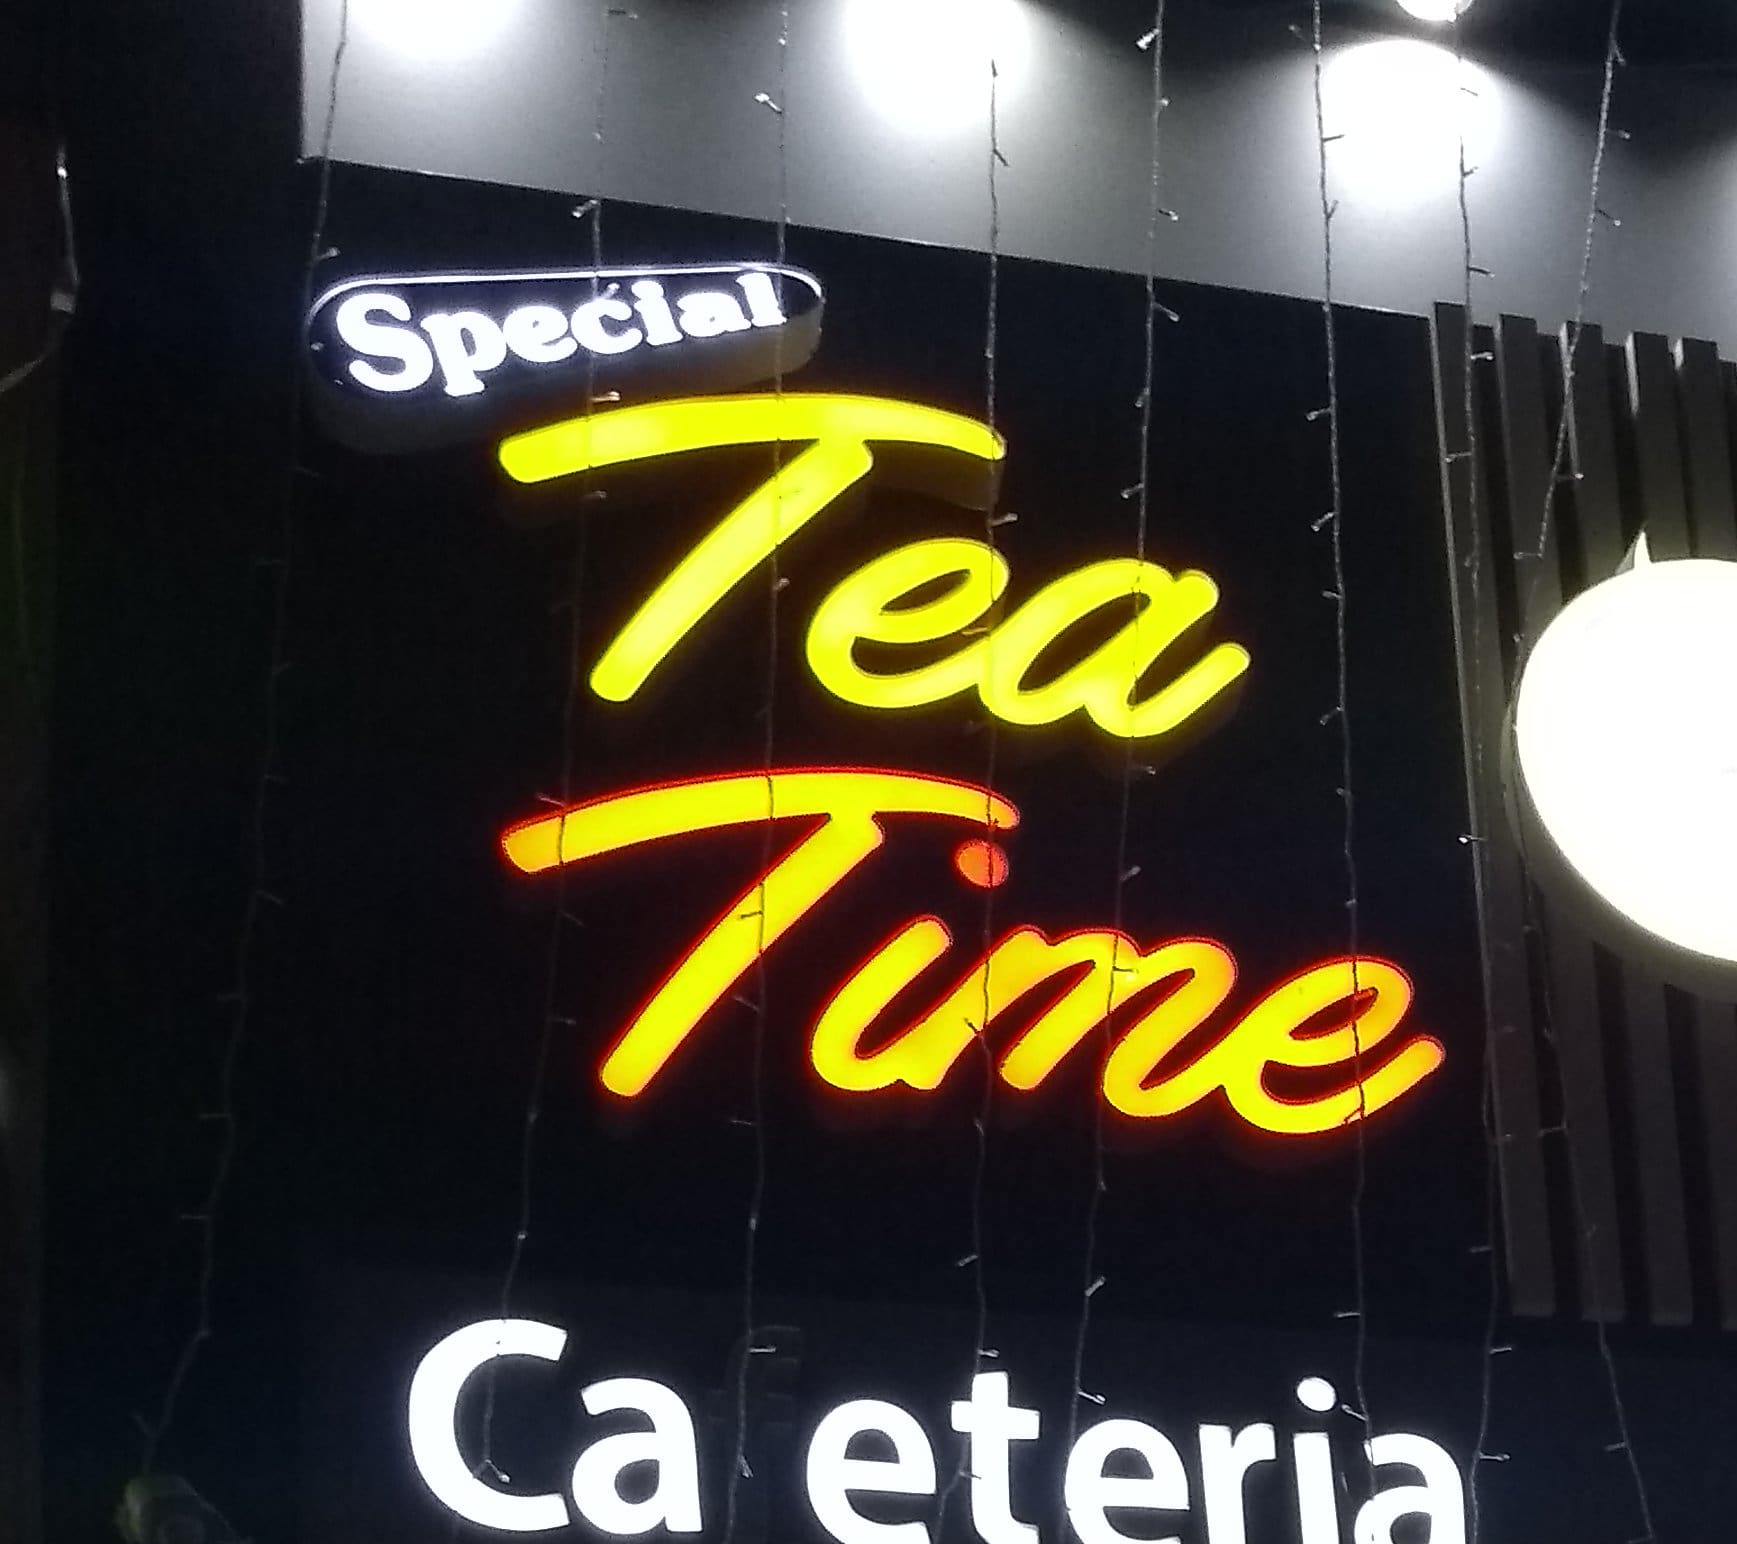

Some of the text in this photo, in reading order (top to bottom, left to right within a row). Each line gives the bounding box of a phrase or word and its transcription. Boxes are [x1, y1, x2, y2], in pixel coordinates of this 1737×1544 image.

[336, 271, 787, 397] Special
[498, 393, 1250, 738] Tea
[500, 765, 1445, 1134] Time
